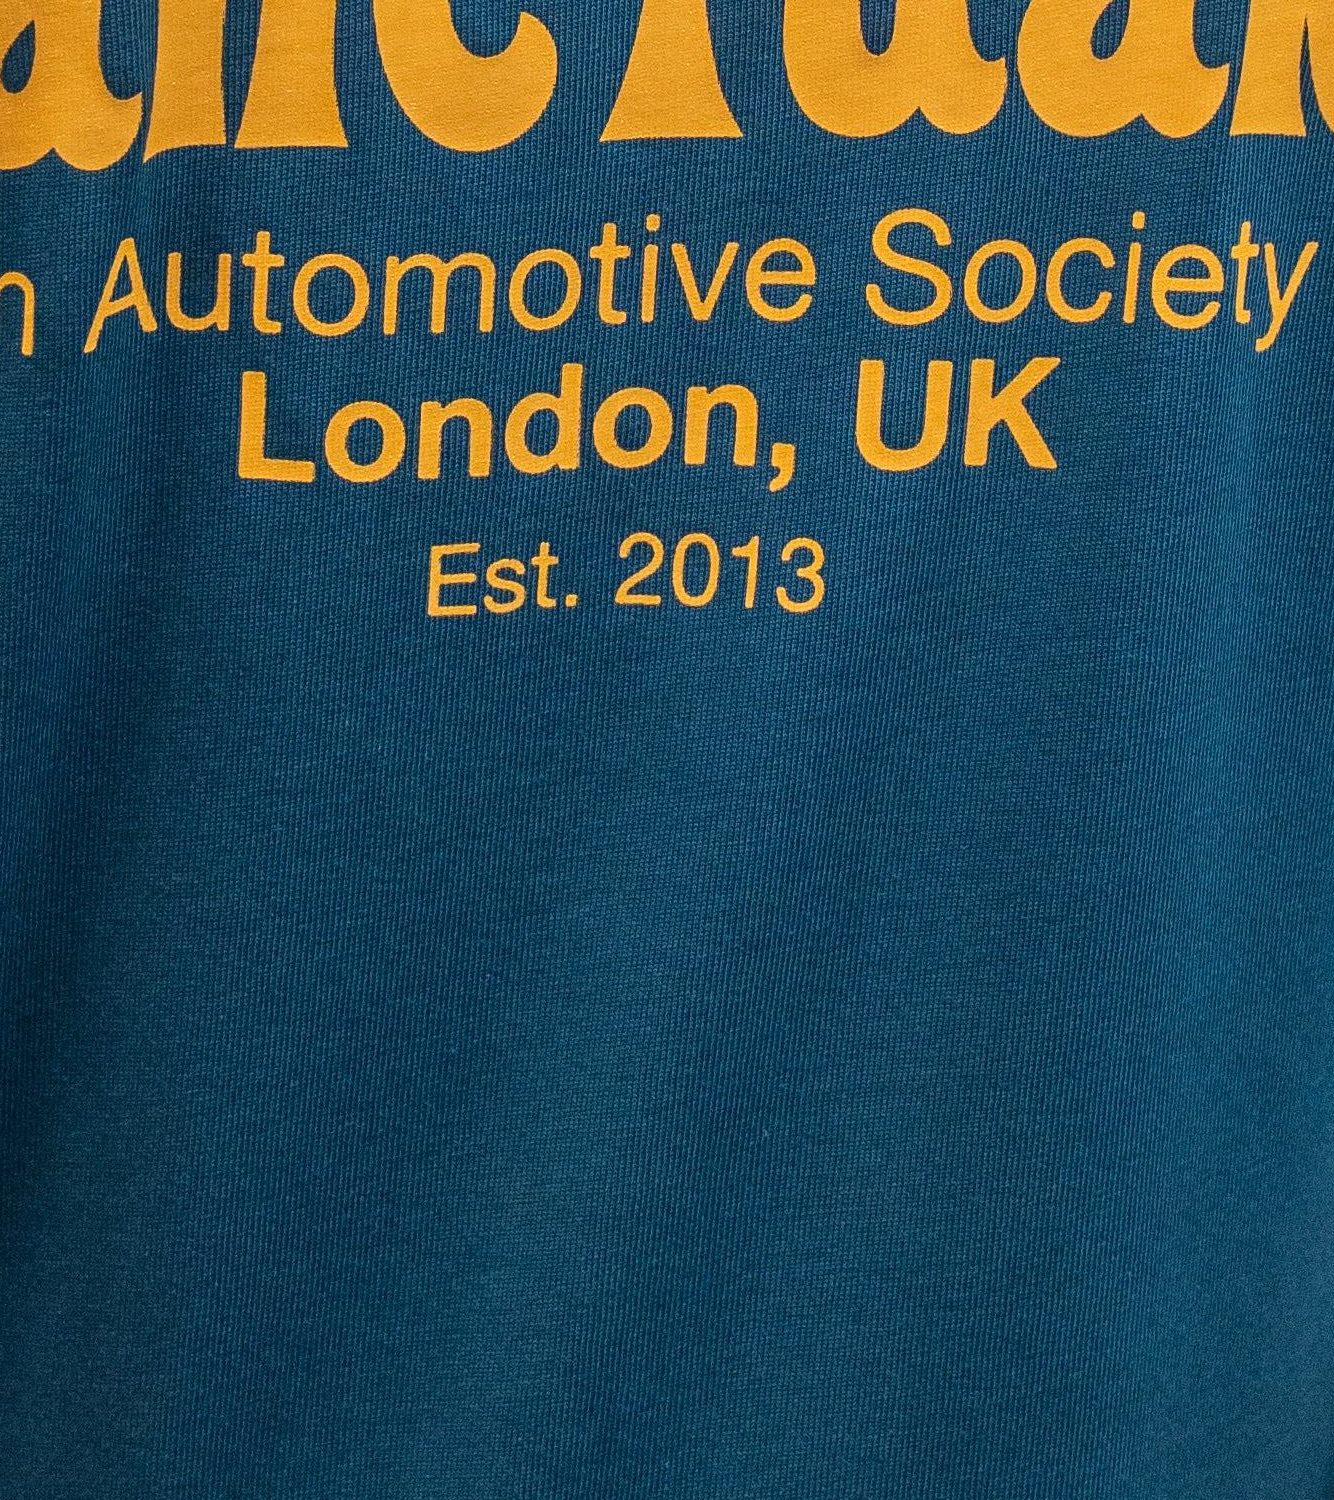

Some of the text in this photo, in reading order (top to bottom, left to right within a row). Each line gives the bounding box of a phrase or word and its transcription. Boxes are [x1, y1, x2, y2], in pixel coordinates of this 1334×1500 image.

[83, 213, 817, 354] Automotive
[865, 207, 1319, 353] Society
[237, 356, 1061, 493] London, UK
[426, 531, 825, 617] Est. 2013
